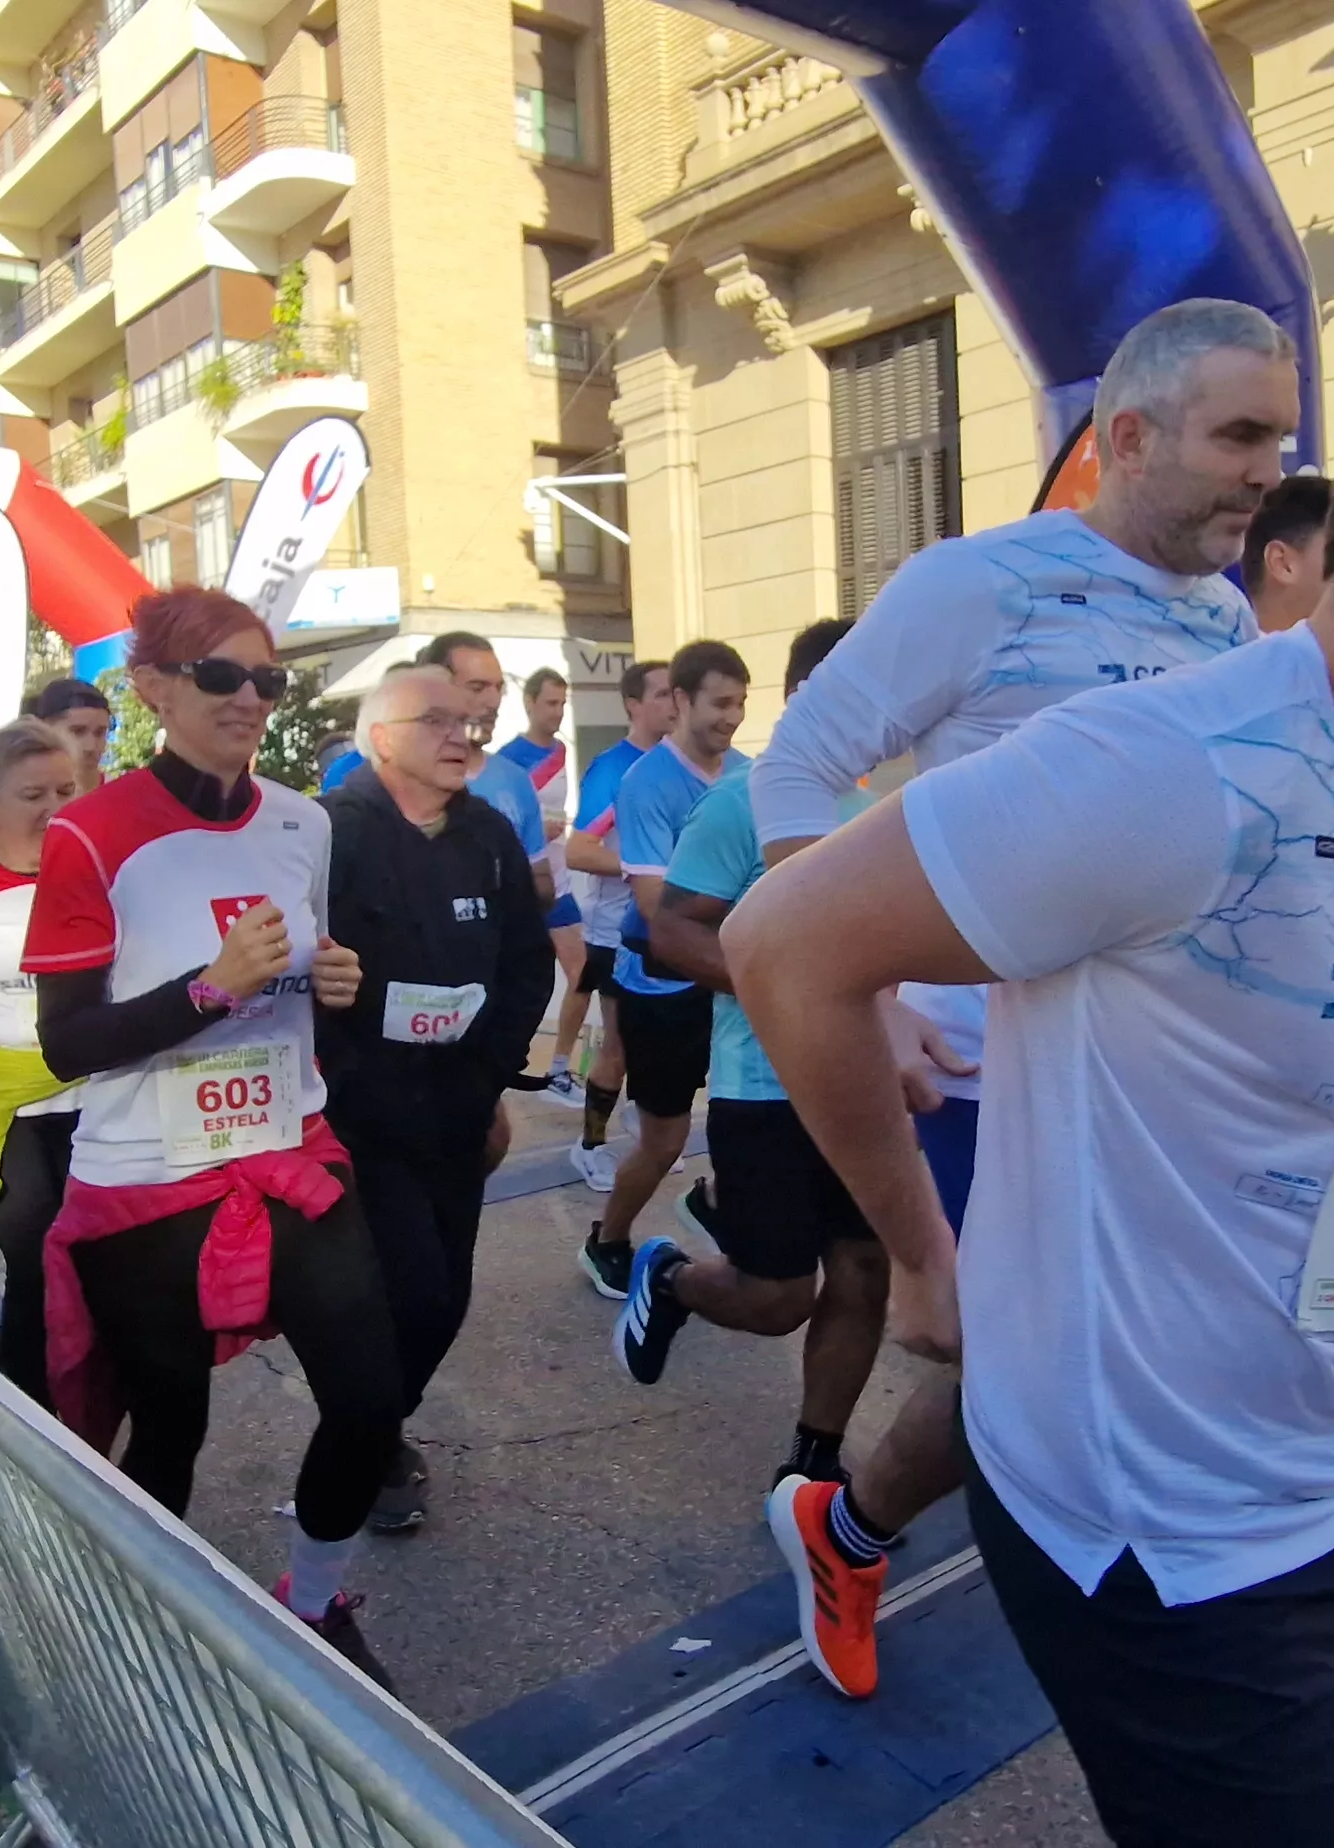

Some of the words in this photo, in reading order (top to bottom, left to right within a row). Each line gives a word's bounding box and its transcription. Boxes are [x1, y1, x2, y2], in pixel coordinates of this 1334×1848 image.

[196, 1073, 273, 1113] 603
[203, 1110, 270, 1133] ESTELA
[209, 1131, 233, 1151] 8K
